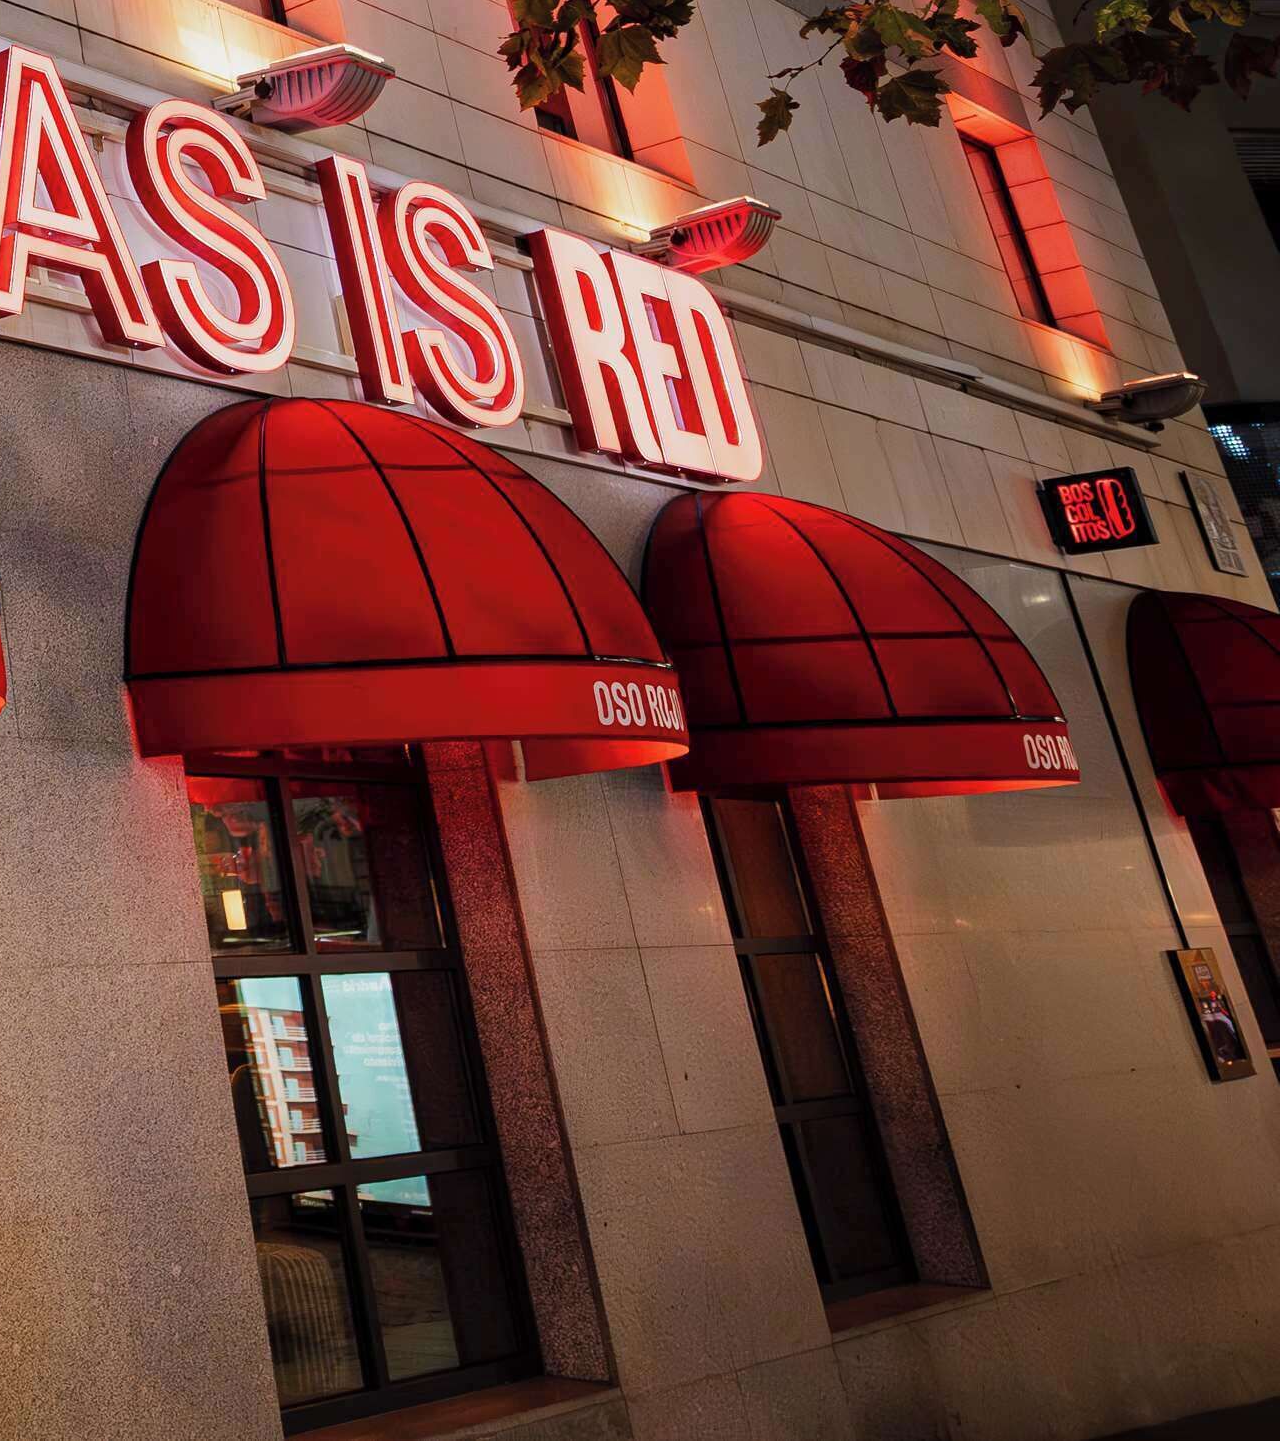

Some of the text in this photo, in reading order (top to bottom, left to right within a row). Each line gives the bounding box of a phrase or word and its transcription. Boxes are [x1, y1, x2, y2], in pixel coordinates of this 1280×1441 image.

[316, 152, 526, 428] IS
[528, 228, 764, 483] RED
[1058, 482, 1094, 505] BOS
[1065, 503, 1101, 524] COL
[1071, 520, 1112, 543] ITOS
[593, 680, 685, 732] OSO ROJO
[1023, 734, 1061, 770] OSO
